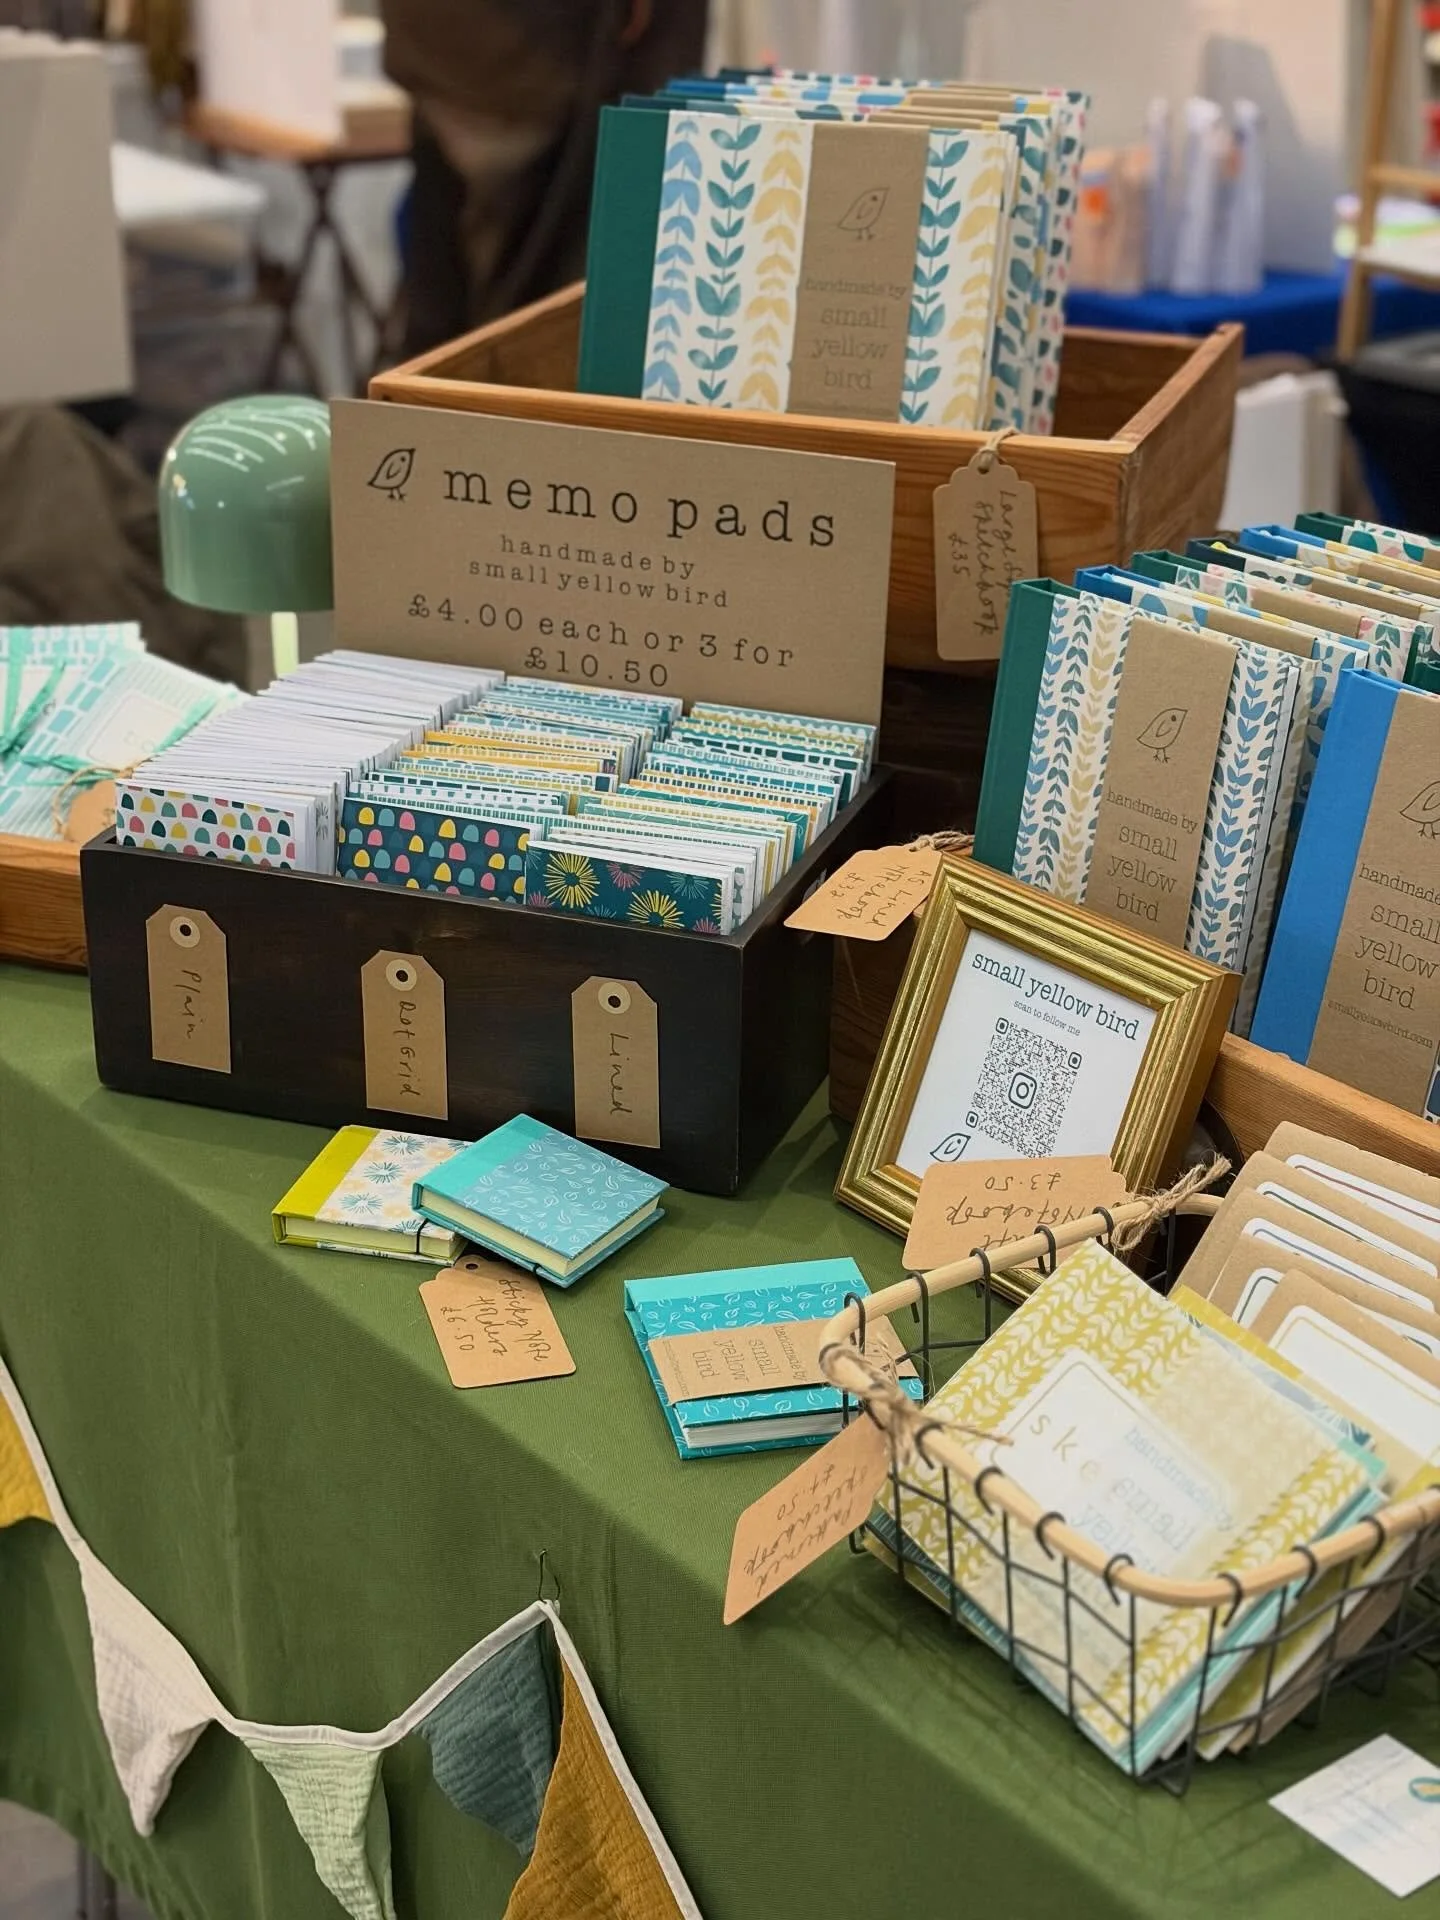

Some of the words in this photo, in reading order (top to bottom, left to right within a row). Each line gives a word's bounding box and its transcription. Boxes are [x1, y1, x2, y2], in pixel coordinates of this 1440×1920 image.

[820, 307, 888, 328] small
[812, 336, 890, 359] yellow
[823, 365, 872, 391] bird
[443, 468, 638, 524] memo
[667, 498, 836, 547] pads
[501, 534, 651, 572] handmade
[663, 555, 695, 579] by
[948, 532, 971, 579] £35
[469, 559, 549, 586] small
[557, 571, 655, 598] yellow
[666, 583, 728, 609] bird
[408, 594, 523, 631] £4.00
[539, 614, 627, 647] each
[644, 631, 683, 653] or
[699, 633, 718, 658] 3
[733, 639, 794, 668] for
[524, 646, 669, 688] £10.50
[1106, 786, 1178, 825] handmade
[1181, 813, 1198, 835] by
[1119, 823, 1177, 861] small
[1107, 855, 1177, 893] yellow
[1115, 886, 1159, 923] bird
[1355, 935, 1440, 979] yellow
[972, 953, 1025, 988] small
[1025, 976, 1093, 1018] yellow
[1095, 1004, 1140, 1041] bird
[1363, 969, 1415, 1011] bird
[1013, 999, 1032, 1015] scan
[1033, 1007, 1042, 1018] to
[1043, 1010, 1067, 1030] follow
[1068, 1022, 1081, 1036] me
[608, 1031, 632, 1116] Lined
[691, 1350, 721, 1380] bird
[713, 1339, 750, 1384] yellow
[749, 1338, 781, 1377] small
